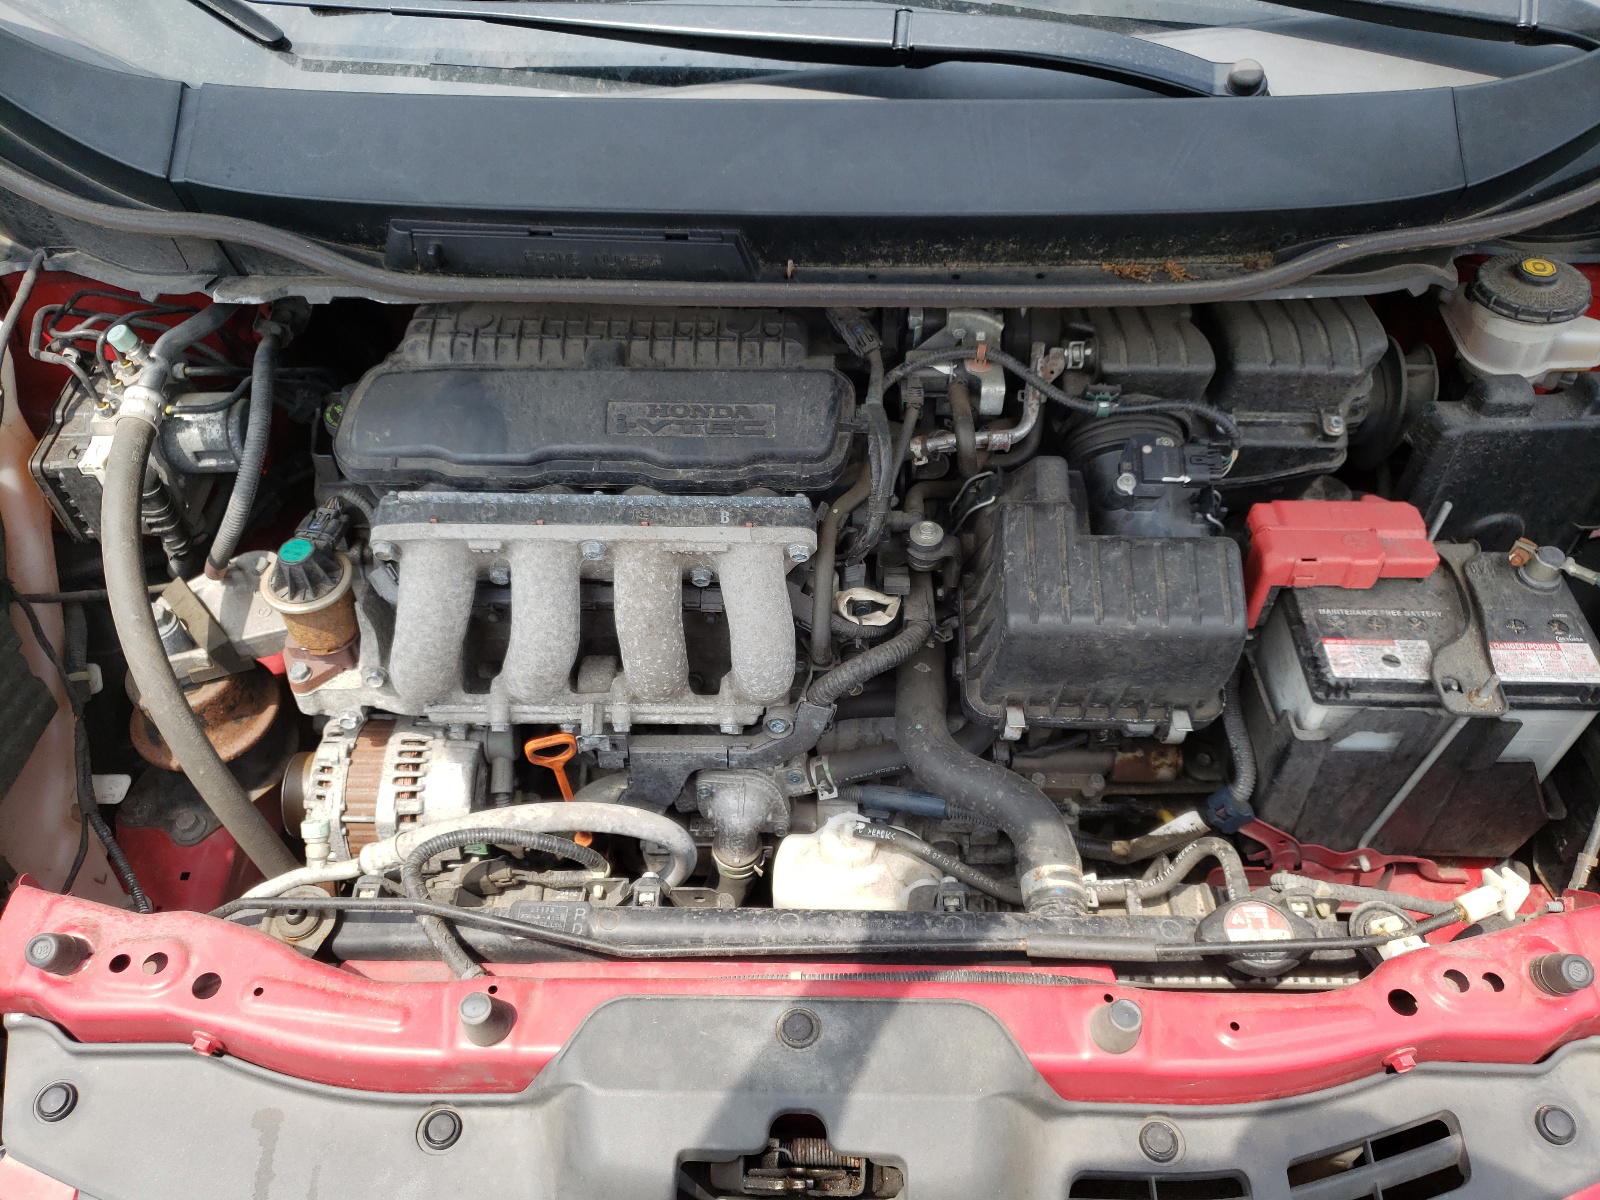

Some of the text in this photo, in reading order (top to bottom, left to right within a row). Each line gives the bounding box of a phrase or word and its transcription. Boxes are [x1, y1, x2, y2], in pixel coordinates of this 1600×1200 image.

[647, 404, 753, 419] HONDA
[720, 511, 730, 524] B
[1318, 608, 1377, 616] MAINTENANCE
[1402, 610, 1442, 618] BATTERY
[1494, 642, 1559, 651] DANGER/POISON
